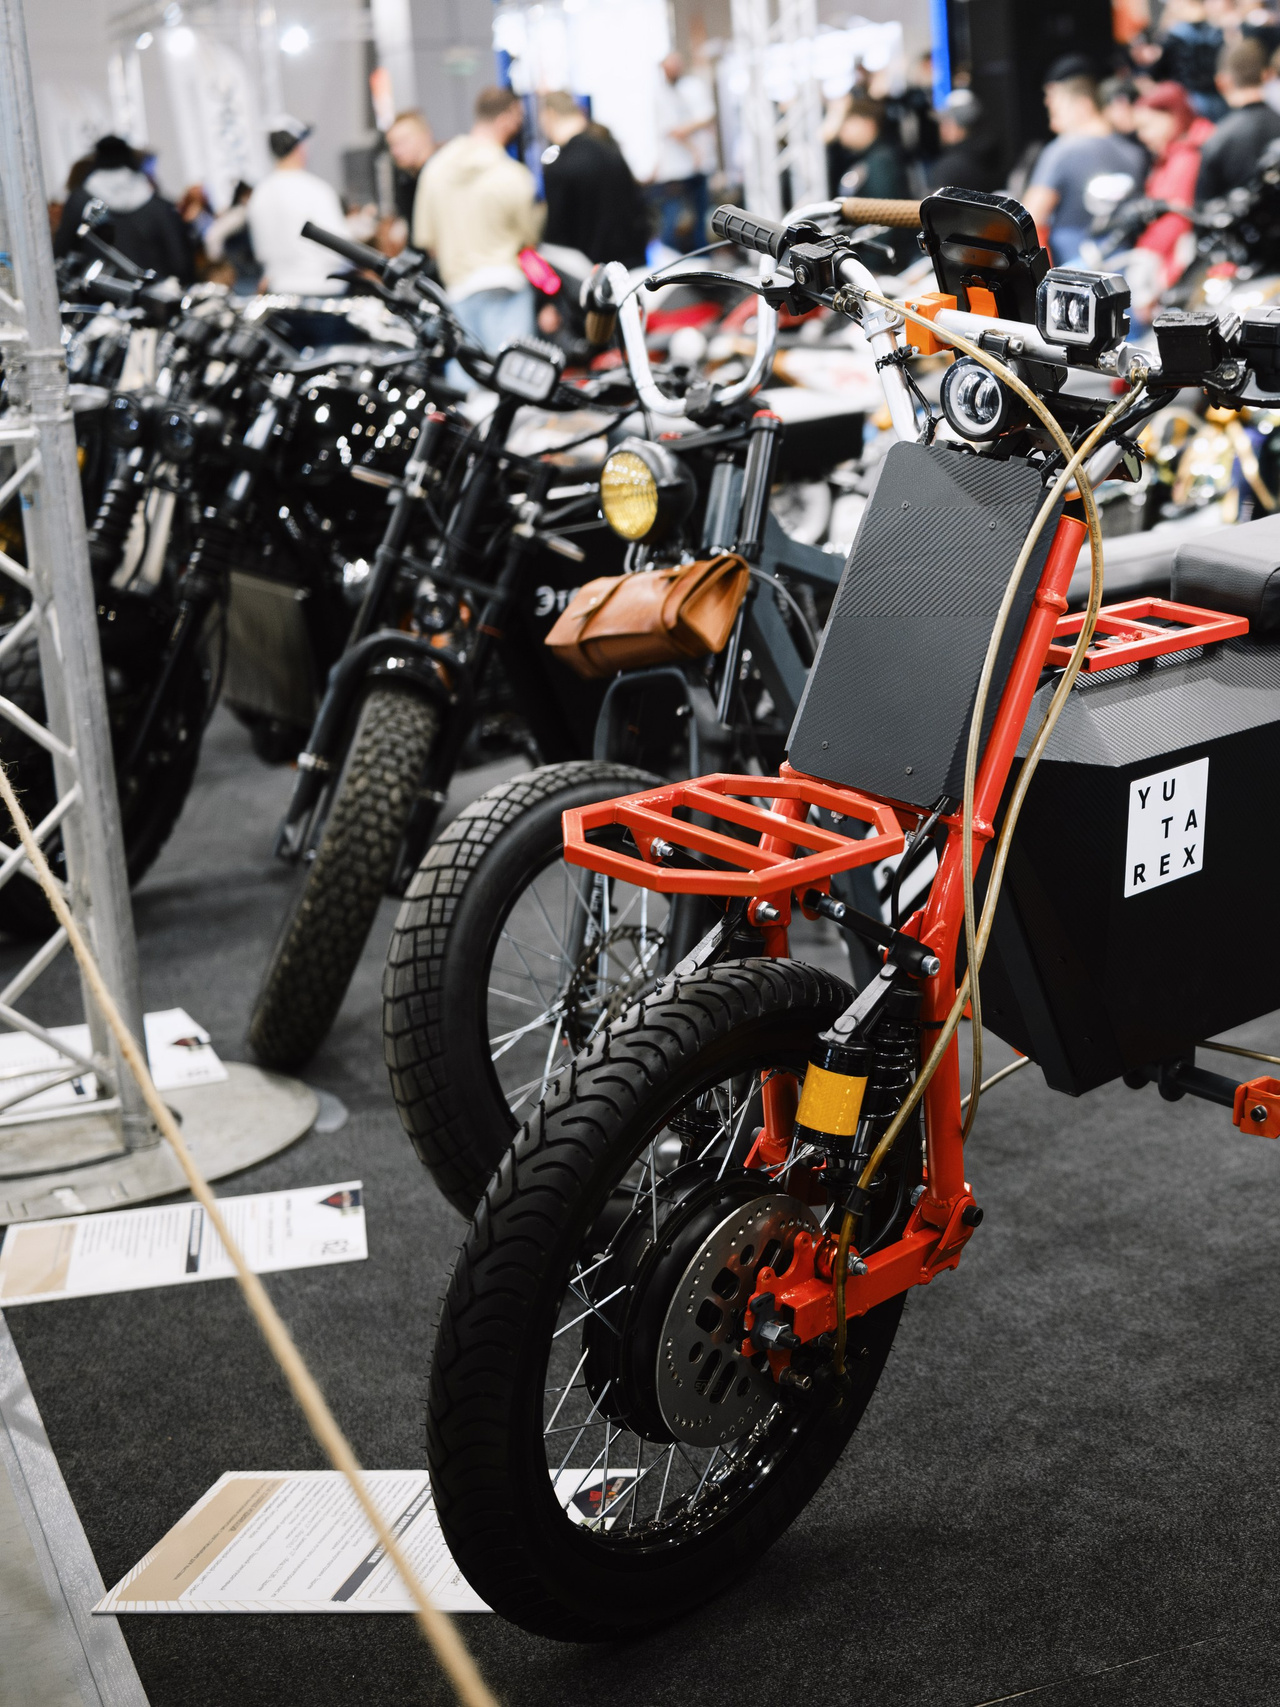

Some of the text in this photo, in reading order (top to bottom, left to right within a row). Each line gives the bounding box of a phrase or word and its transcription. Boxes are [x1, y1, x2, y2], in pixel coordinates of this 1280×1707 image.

[1138, 778, 1175, 809] YU
[1161, 809, 1198, 839] TA
[1133, 844, 1196, 886] REX
